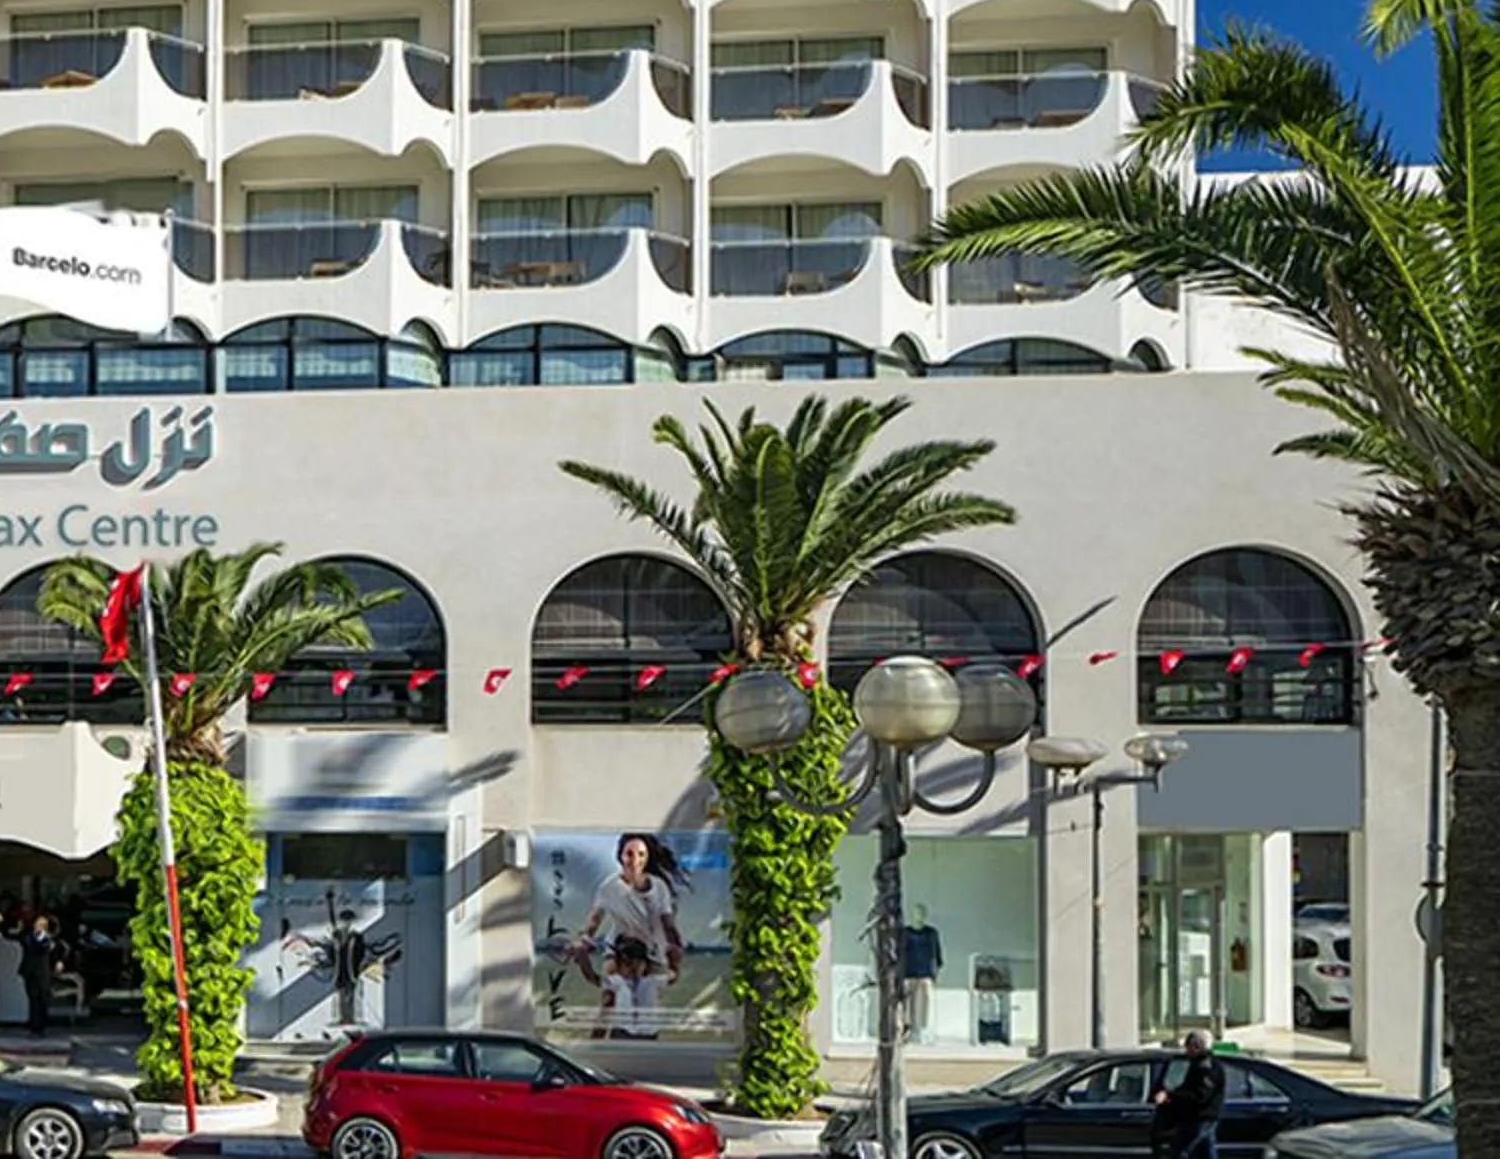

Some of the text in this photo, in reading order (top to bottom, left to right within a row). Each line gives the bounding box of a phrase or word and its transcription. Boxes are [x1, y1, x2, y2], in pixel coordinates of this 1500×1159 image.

[12, 246, 142, 285] Barcelo.com
[100, 405, 214, 490] نزل
[56, 503, 219, 548] Centre
